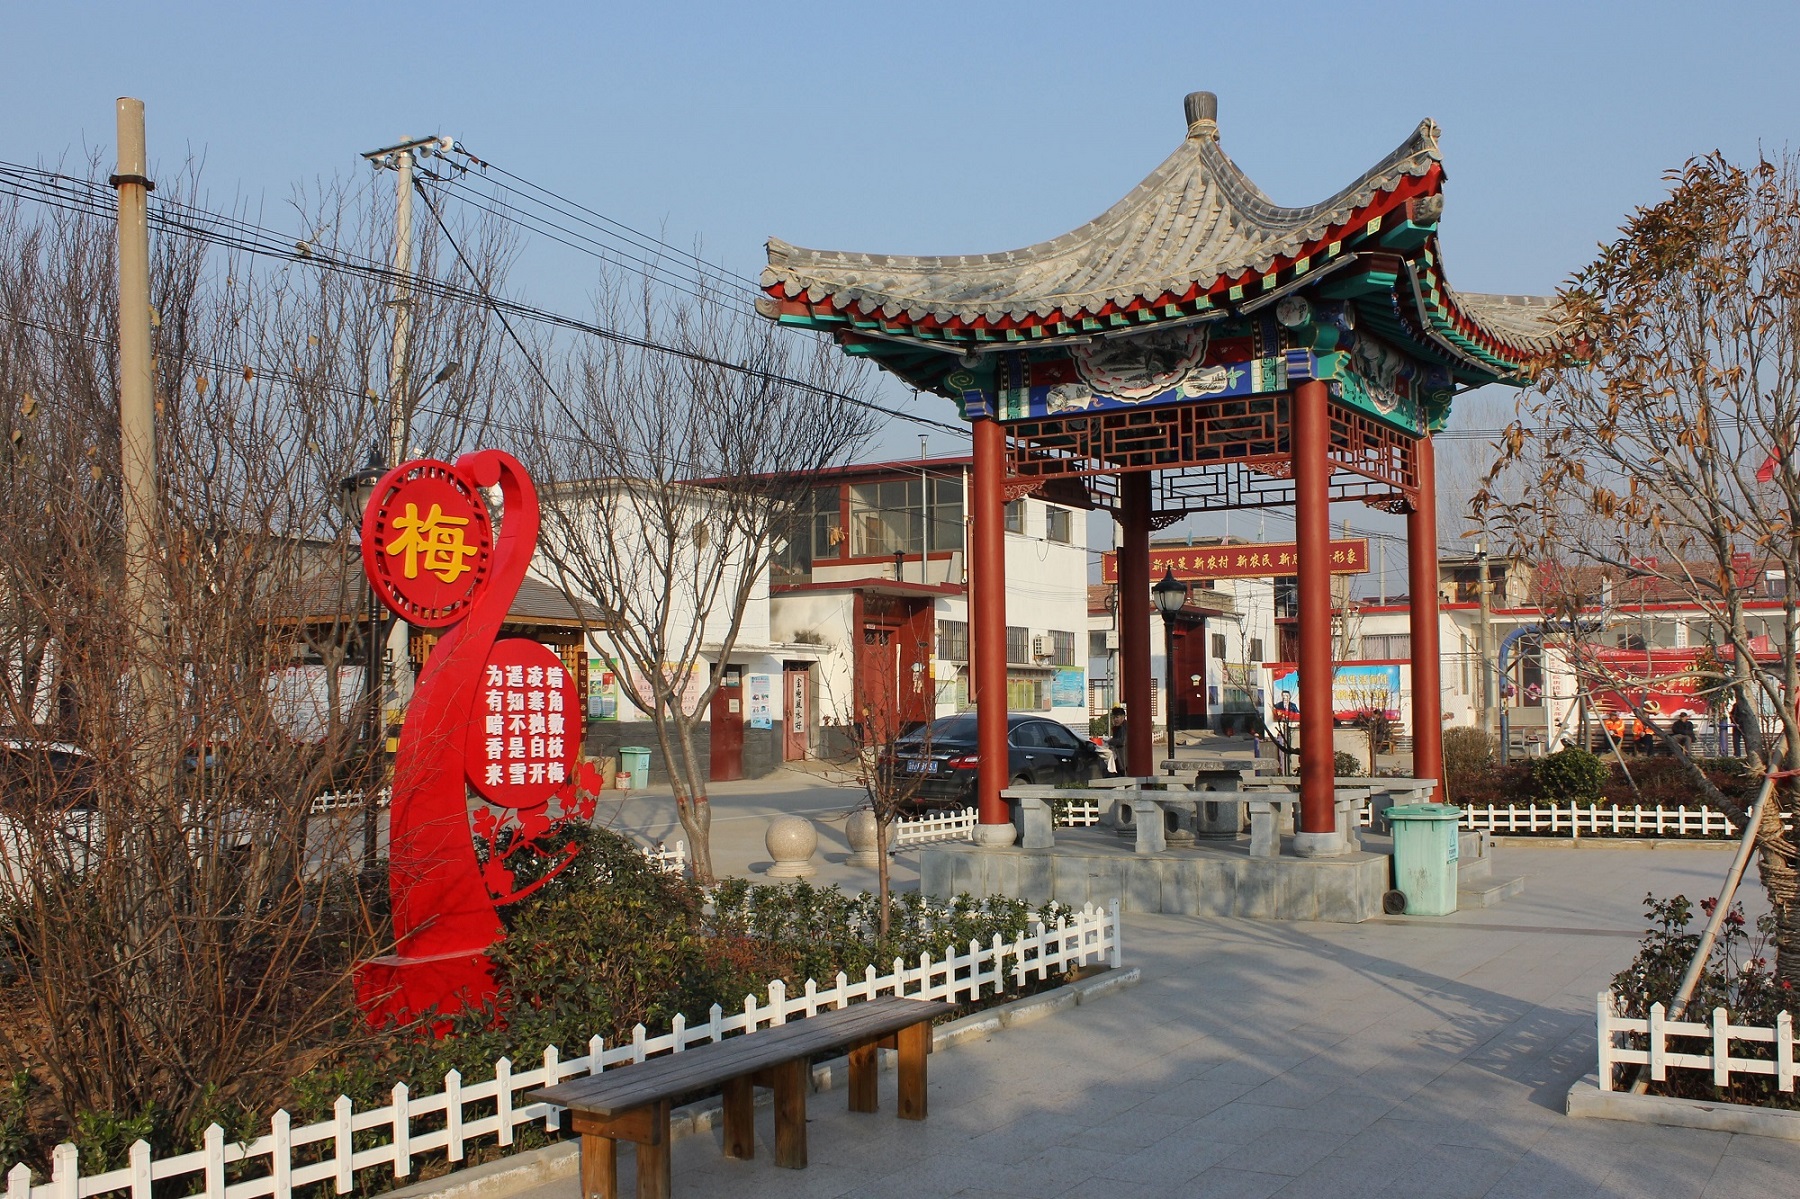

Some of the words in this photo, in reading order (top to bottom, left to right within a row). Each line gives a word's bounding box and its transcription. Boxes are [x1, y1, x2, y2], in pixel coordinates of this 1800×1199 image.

[385, 502, 478, 583] 梅
[1151, 557, 1189, 573] 新政策
[1193, 555, 1229, 571] 新农村
[1236, 553, 1273, 569] 新农民
[1328, 548, 1358, 565] 形象
[484, 664, 506, 787] 为有暗香来
[504, 665, 528, 786] 遥知不是雪
[526, 664, 548, 785] 凌寒独自开
[546, 664, 567, 785] 墙角数枝梅
